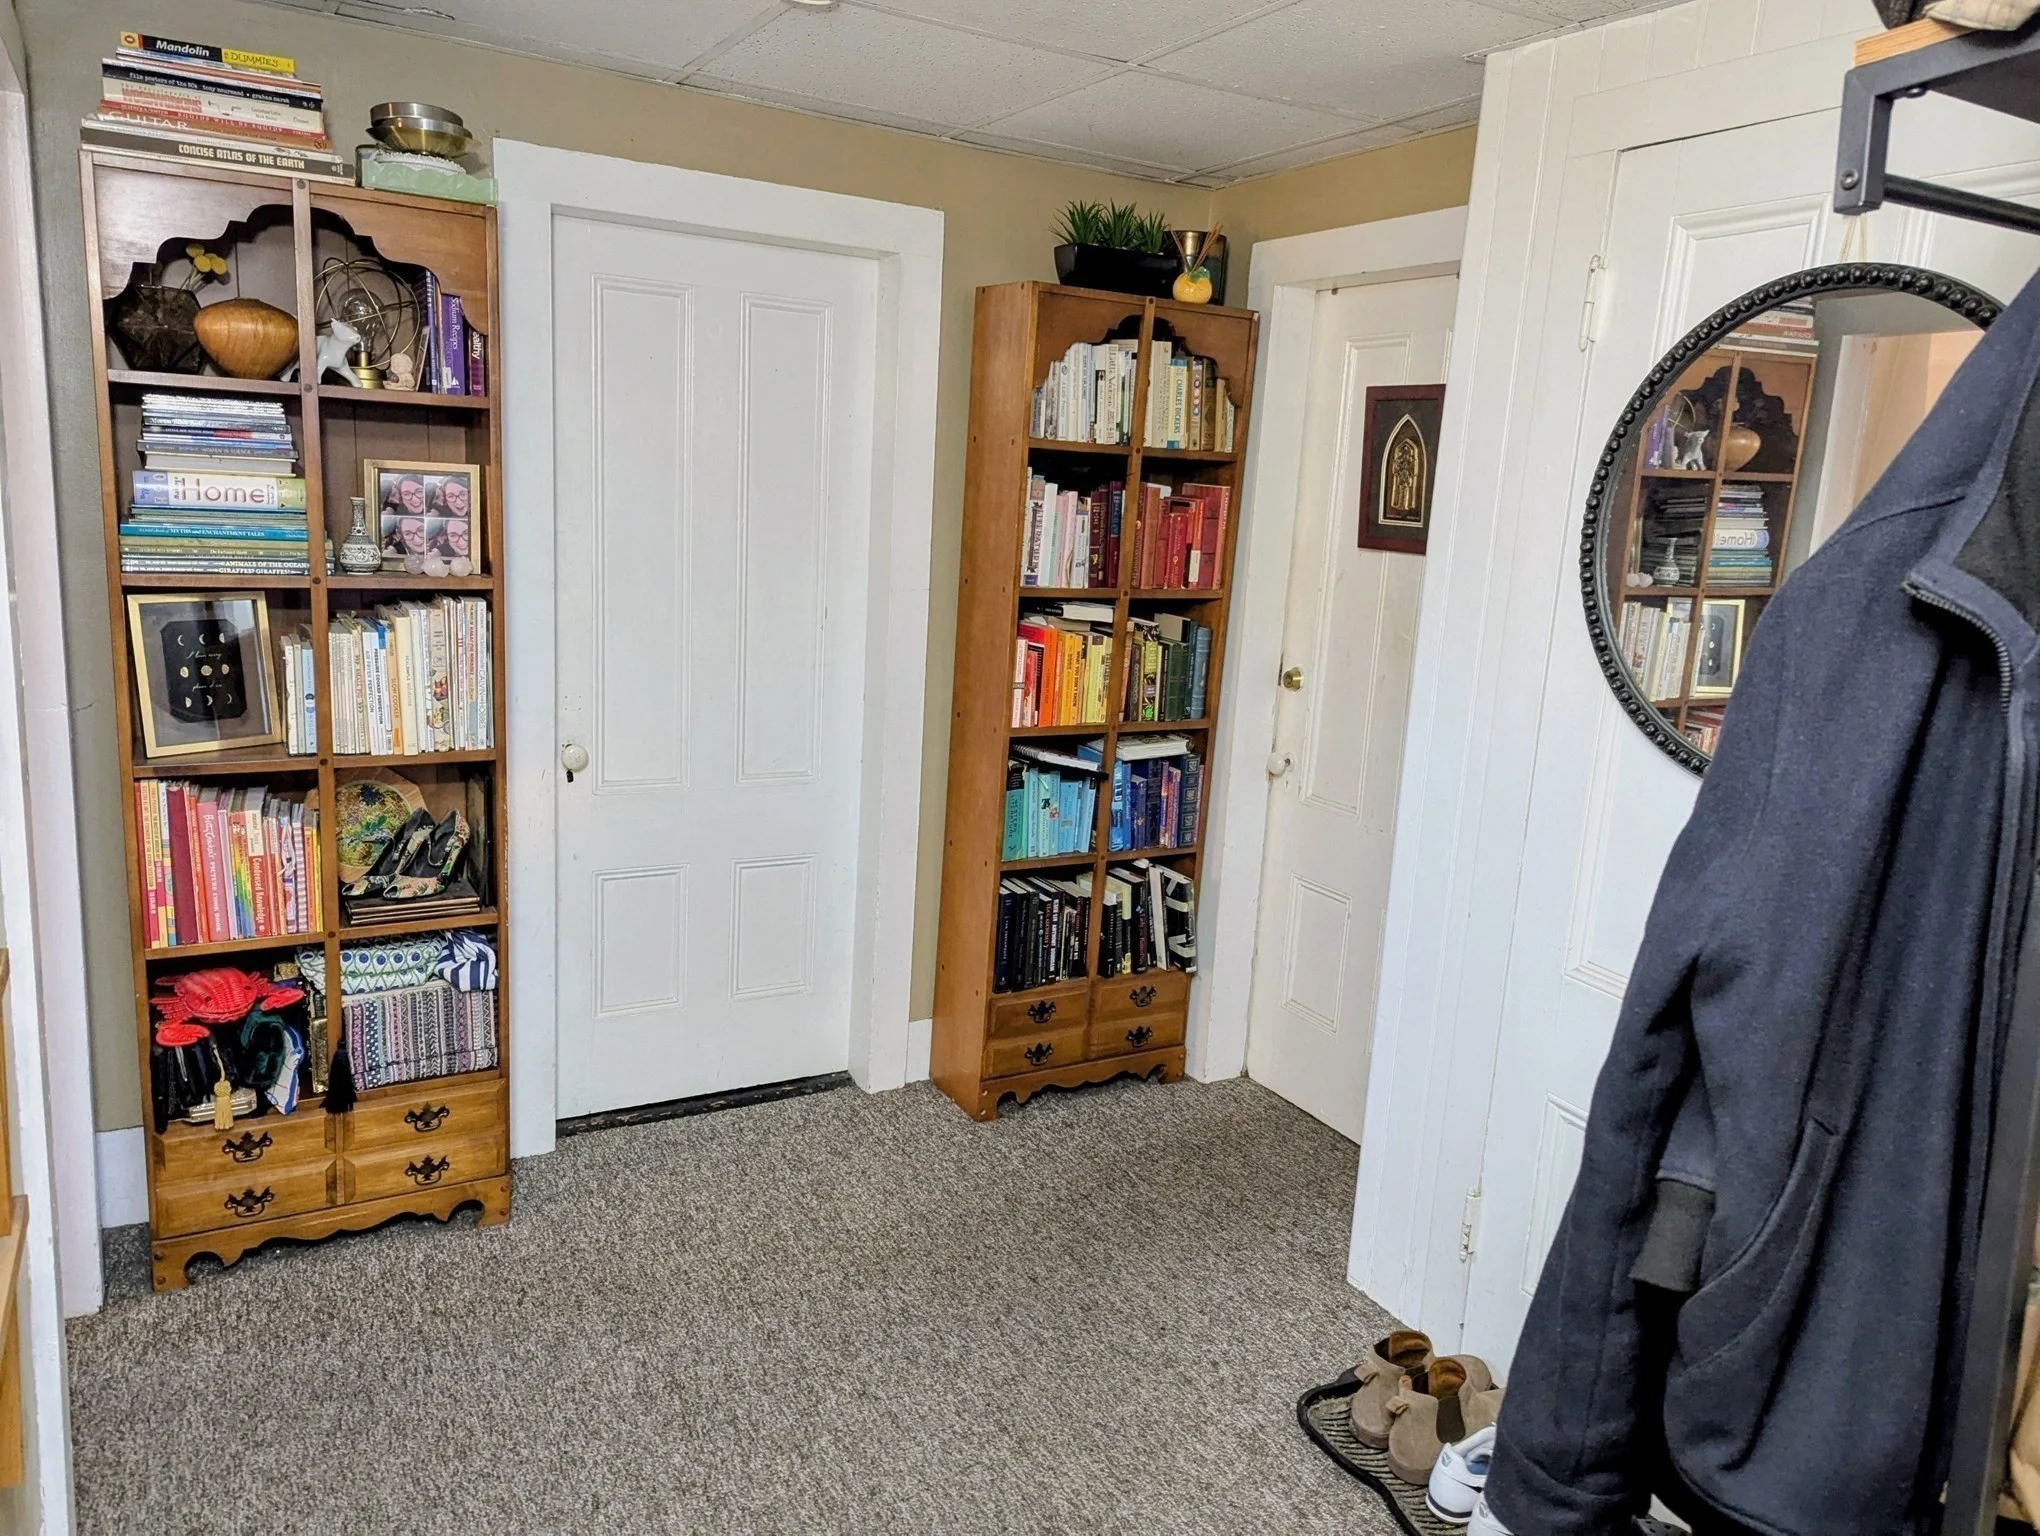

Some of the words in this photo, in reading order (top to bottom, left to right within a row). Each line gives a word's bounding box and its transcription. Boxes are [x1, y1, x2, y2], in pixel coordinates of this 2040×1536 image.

[155, 40, 210, 56] Mandolin
[230, 52, 278, 67] DUMMIES
[144, 74, 167, 85] posters
[105, 111, 189, 130] GUITAR
[178, 143, 214, 157] CONCISE
[215, 149, 243, 161] ATLAS
[245, 153, 256, 163] OF
[258, 155, 275, 165] THE
[276, 157, 305, 169] EARTH
[1108, 351, 1116, 374] Little
[1107, 375, 1115, 406] Women
[1173, 407, 1181, 433] DICKENS
[181, 477, 265, 503] Home
[202, 528, 245, 537] ENCHANTMENT
[1032, 508, 1043, 566] LITERATURE
[218, 566, 254, 574] GIRAFFES?
[225, 559, 256, 567] ANIMALS
[477, 669, 485, 694] CALVIN
[366, 679, 375, 712] PERFECTION
[376, 694, 384, 724] PERFECTION
[1113, 771, 1123, 801] WILD
[201, 814, 215, 832] Betty
[204, 831, 218, 858] Crocker's
[209, 861, 217, 891] PICTURE
[251, 857, 264, 891] Condensed
[253, 891, 267, 924] Knowledge
